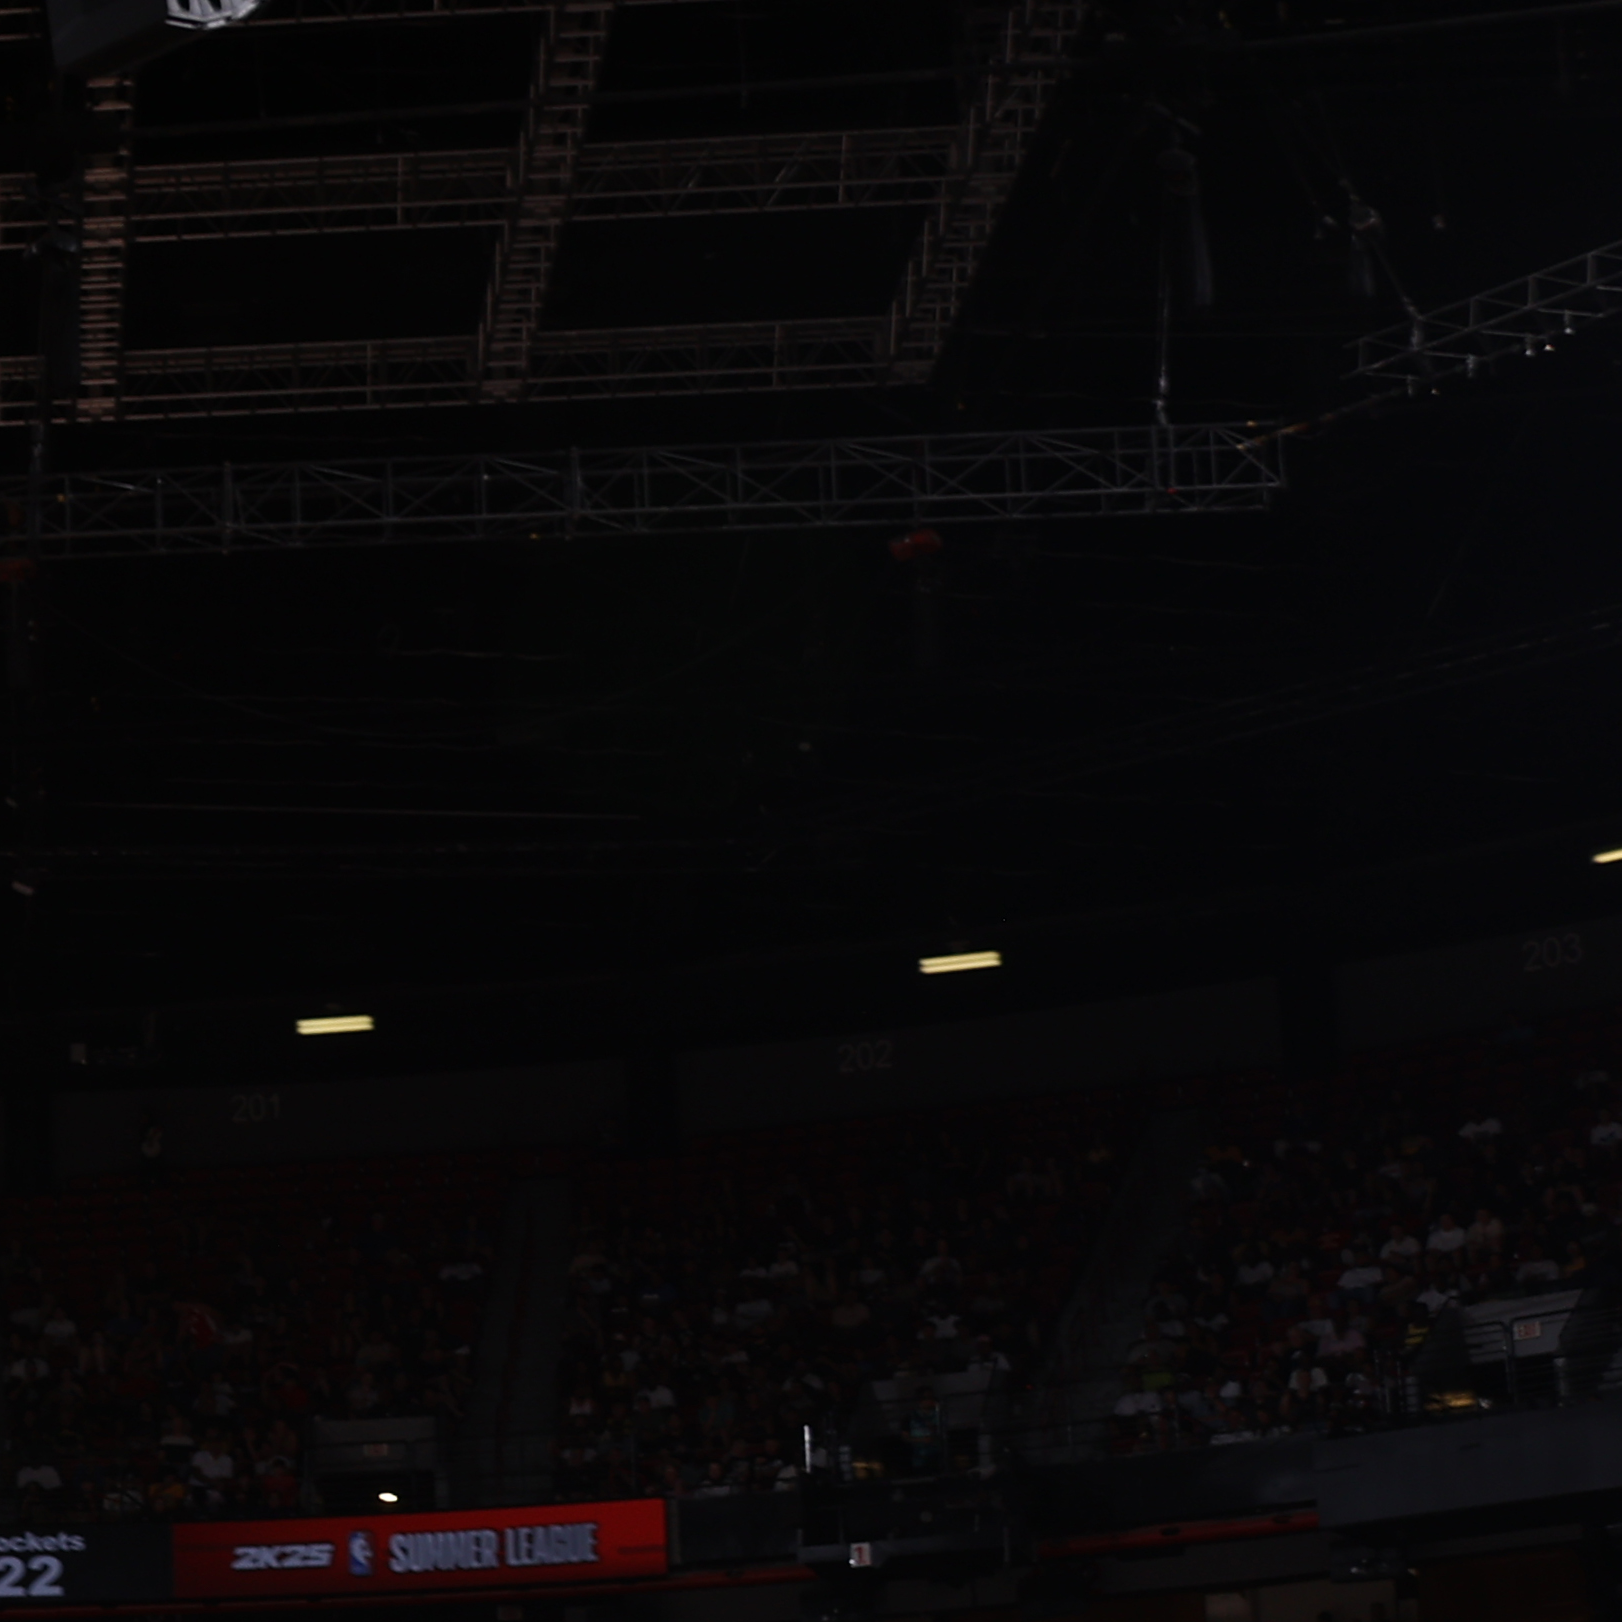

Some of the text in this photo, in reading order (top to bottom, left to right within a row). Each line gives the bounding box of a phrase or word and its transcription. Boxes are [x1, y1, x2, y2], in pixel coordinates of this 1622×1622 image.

[1520, 933, 1585, 973] 203
[836, 1039, 894, 1075] 202
[230, 1093, 283, 1123] 201
[231, 1522, 600, 1573] 2K25 SUMMER LEAGUE
